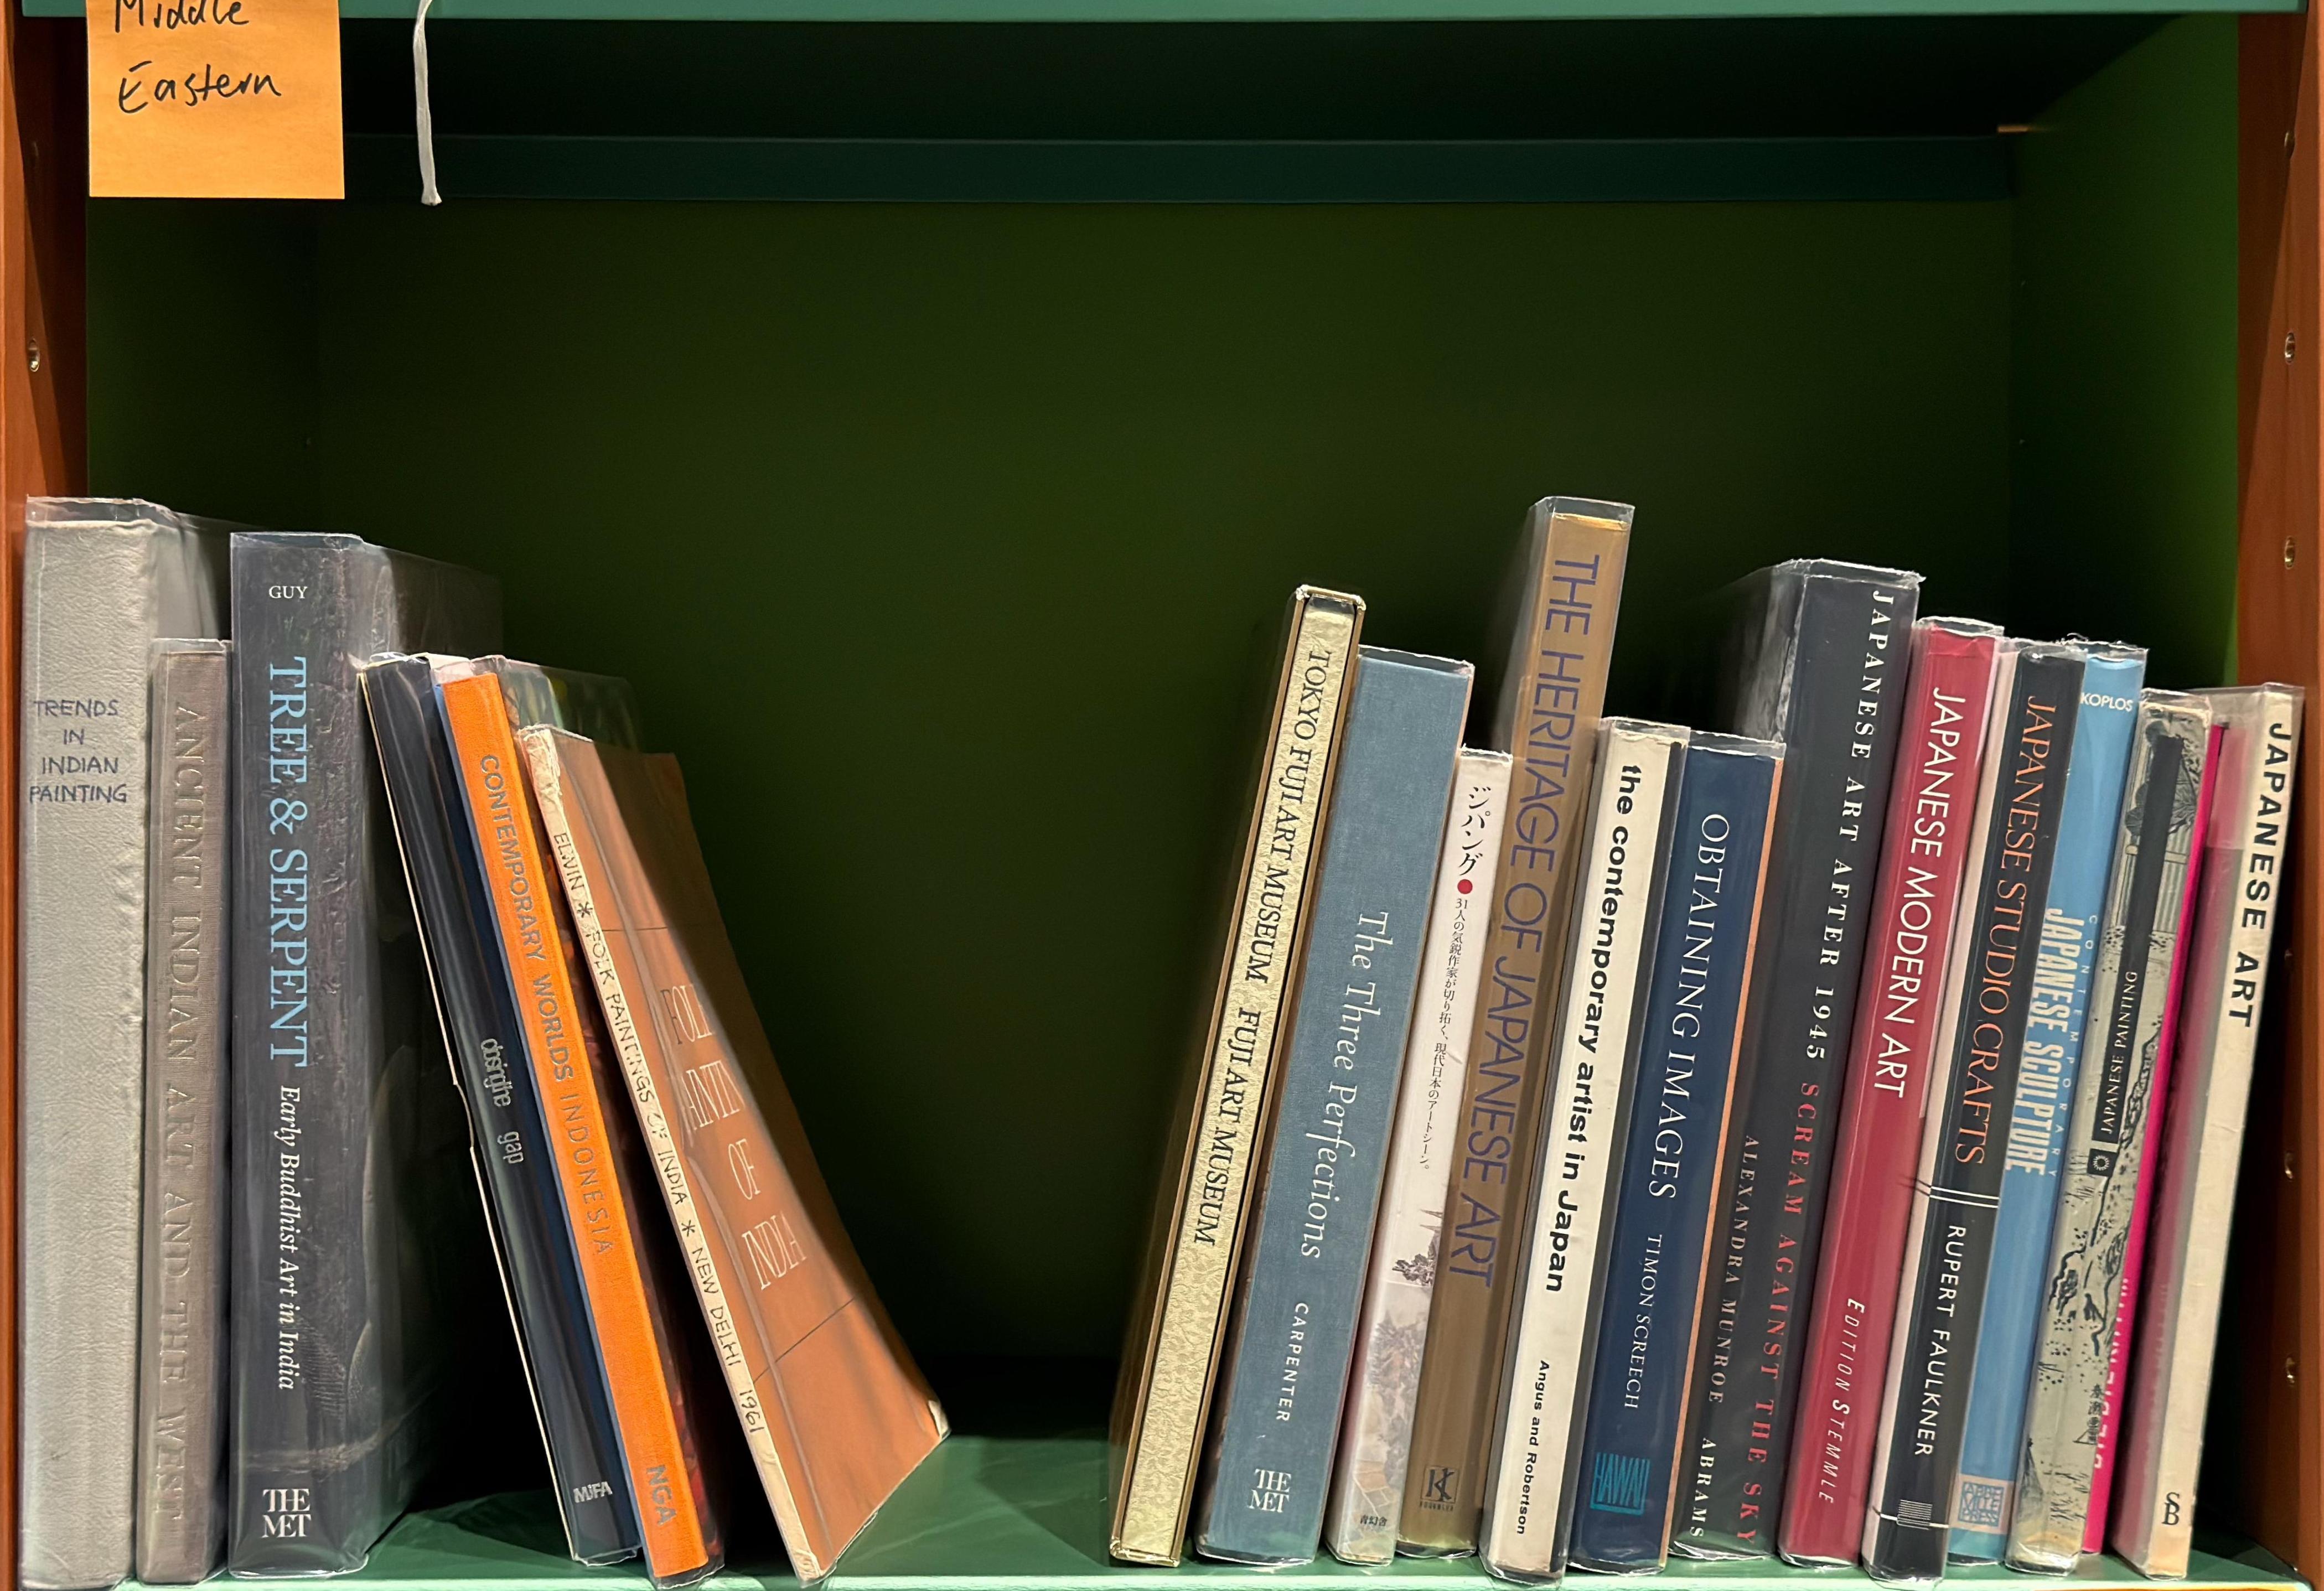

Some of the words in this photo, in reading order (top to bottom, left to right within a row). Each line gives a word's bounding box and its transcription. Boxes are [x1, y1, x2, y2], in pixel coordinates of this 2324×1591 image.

[118, 60, 282, 113] Eastern
[268, 585, 308, 599] GUY
[1545, 554, 1601, 635] THE
[34, 699, 118, 716] TRENDS
[1293, 650, 1332, 740] TOKYO
[1851, 590, 1895, 759] JAPANESE
[2079, 692, 2134, 713] KOPLOS
[63, 729, 84, 745] IN
[269, 656, 308, 784] TREE
[1510, 650, 1584, 872] HERITAGE
[29, 783, 127, 804] PAINTING
[42, 756, 118, 775] INDIAN
[172, 701, 206, 888] ANCIENT
[1279, 746, 1312, 805] FUJI
[1616, 764, 1642, 816] the
[1839, 776, 1865, 842] ART
[1910, 687, 1966, 858] JAPANESE
[2000, 695, 2057, 872] JAPANESE
[269, 797, 308, 835] &
[1270, 809, 1301, 862] ART
[1458, 785, 1492, 877] ジパング
[2241, 722, 2292, 931] JAPANESE
[1245, 867, 1290, 984] MUSEUM
[1352, 911, 1394, 970] The
[1500, 882, 1547, 953] OF
[1578, 825, 1629, 1054] contemporary
[1671, 813, 1730, 1039] OBTAINING
[1819, 858, 1853, 966] AFTER
[1883, 866, 1939, 1024] MODERN
[1979, 879, 2027, 1015] STUDIO
[168, 909, 201, 1060] INDIAN
[270, 848, 309, 1067] SERPENT
[2025, 908, 2085, 1033] JAPANESE
[2228, 951, 2260, 1028] ART
[480, 754, 547, 962] CONTEMPORARY
[532, 974, 574, 1082] WORLDS
[559, 1093, 614, 1255] INDONESIA
[1227, 1007, 1262, 1067] FUJI
[1334, 982, 1381, 1071] Three
[1806, 985, 1834, 1060] 1945
[2048, 915, 2098, 1178] CONTEMPORARY
[1218, 1068, 1249, 1123] ART
[1463, 955, 1536, 1185] JAPANESE
[1873, 1033, 1911, 1098] ART
[1955, 1022, 2004, 1164] CRAFTS
[2100, 1055, 2125, 1135] JAPANESE
[2114, 971, 2138, 1049] PAINTING
[165, 1083, 195, 1168] ART
[274, 1085, 301, 1147] Early
[553, 832, 585, 891] ELWIN
[586, 929, 615, 983] FOLK
[606, 993, 655, 1103] PAINTINGS
[658, 1149, 688, 1205] INDIA
[692, 1246, 719, 1295] NEW
[710, 1306, 742, 1367] DELHI
[739, 1389, 765, 1433] 1961
[1567, 1062, 1595, 1143] artist
[1648, 1049, 1696, 1199] IMAGES
[2004, 1040, 2064, 1177] SCULPTURE
[498, 1131, 525, 1165] gap
[728, 1139, 761, 1200] OF
[1193, 1126, 1238, 1247] MUSEUM
[1301, 1081, 1358, 1259] Perfections
[1562, 1152, 1586, 1180] in
[1784, 1082, 1820, 1214] SCREAM
[161, 1192, 193, 1278] AND
[278, 1153, 301, 1251] Buddhist
[1449, 1192, 1501, 1289] ART
[1546, 1190, 1578, 1293] Japan
[1724, 1135, 1759, 1284] ALEXANDRA
[278, 1257, 300, 1298] Art
[742, 1211, 807, 1291] INDIA
[1639, 1234, 1663, 1308] TIMON
[1937, 1225, 1966, 1318] RUPERT
[160, 1301, 189, 1383] THE
[278, 1303, 296, 1324] in
[1708, 1299, 1737, 1403] MUNROE
[1761, 1233, 1798, 1380] AGAINST
[1835, 1298, 1865, 1391] EDITION
[278, 1331, 300, 1390] India
[1276, 1302, 1309, 1422] CARPENTER
[1534, 1360, 1550, 1411] Angus
[1624, 1314, 1651, 1409] SCREECH
[1914, 1328, 1950, 1457] FAULKNER
[156, 1412, 186, 1520] WEST
[1530, 1417, 1540, 1447] and
[1748, 1399, 1774, 1464] THE
[1819, 1399, 1850, 1504] STEMMLE
[262, 1489, 310, 1512] THE
[646, 1466, 677, 1526] NGA
[1250, 1489, 1290, 1513] MET
[1254, 1469, 1292, 1493] THE
[1516, 1452, 1538, 1535] Robertson
[1689, 1437, 1717, 1537] ABRAMS
[1737, 1481, 1763, 1544] SKY
[261, 1514, 311, 1538] MET
